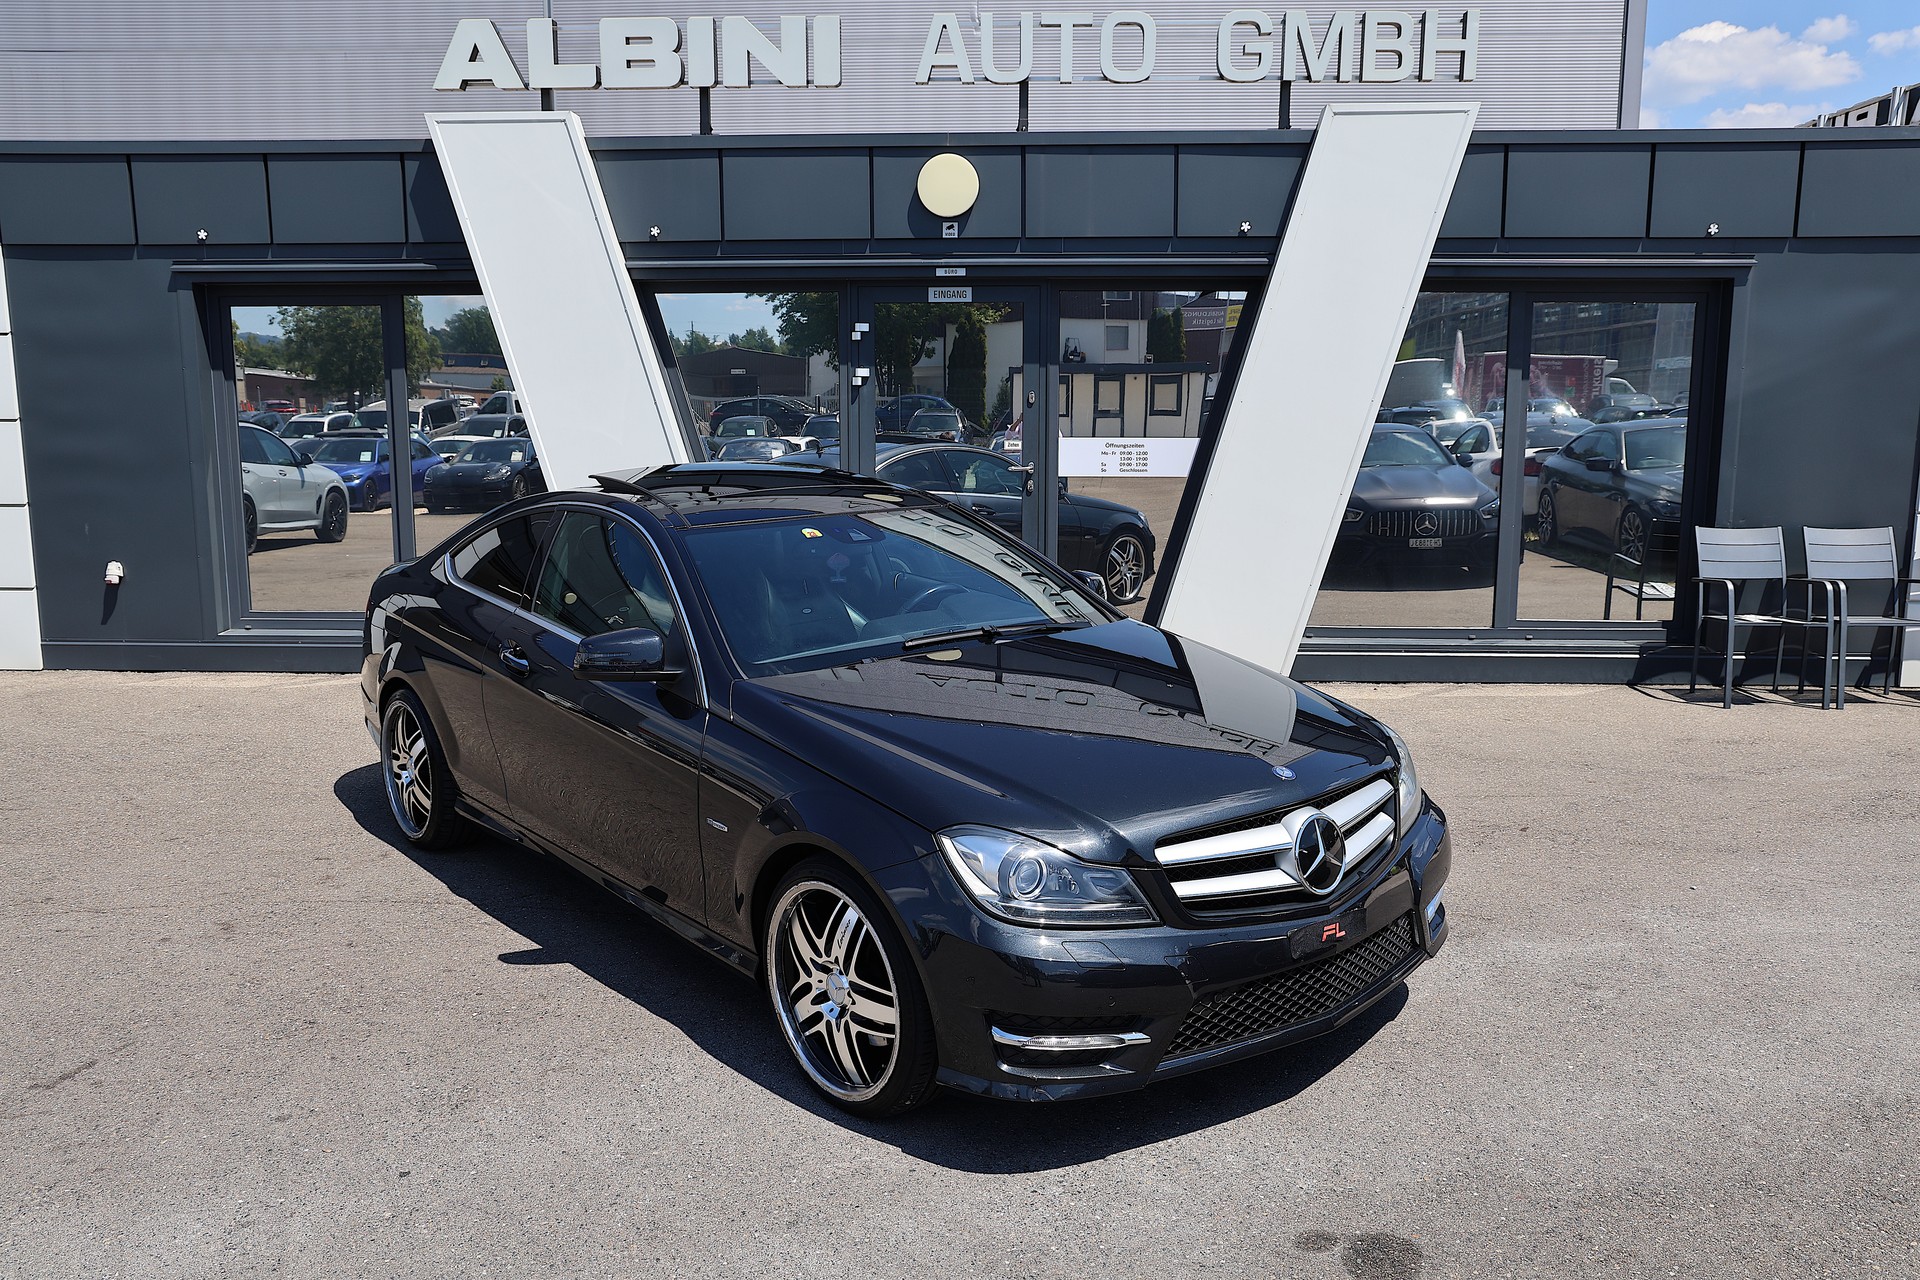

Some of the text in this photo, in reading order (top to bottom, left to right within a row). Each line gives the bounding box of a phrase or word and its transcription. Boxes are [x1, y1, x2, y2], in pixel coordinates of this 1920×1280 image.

[433, 9, 1481, 91] ALBINI AUTO GMBH
[933, 290, 968, 299] EINGANG
[1322, 922, 1346, 942] FL
